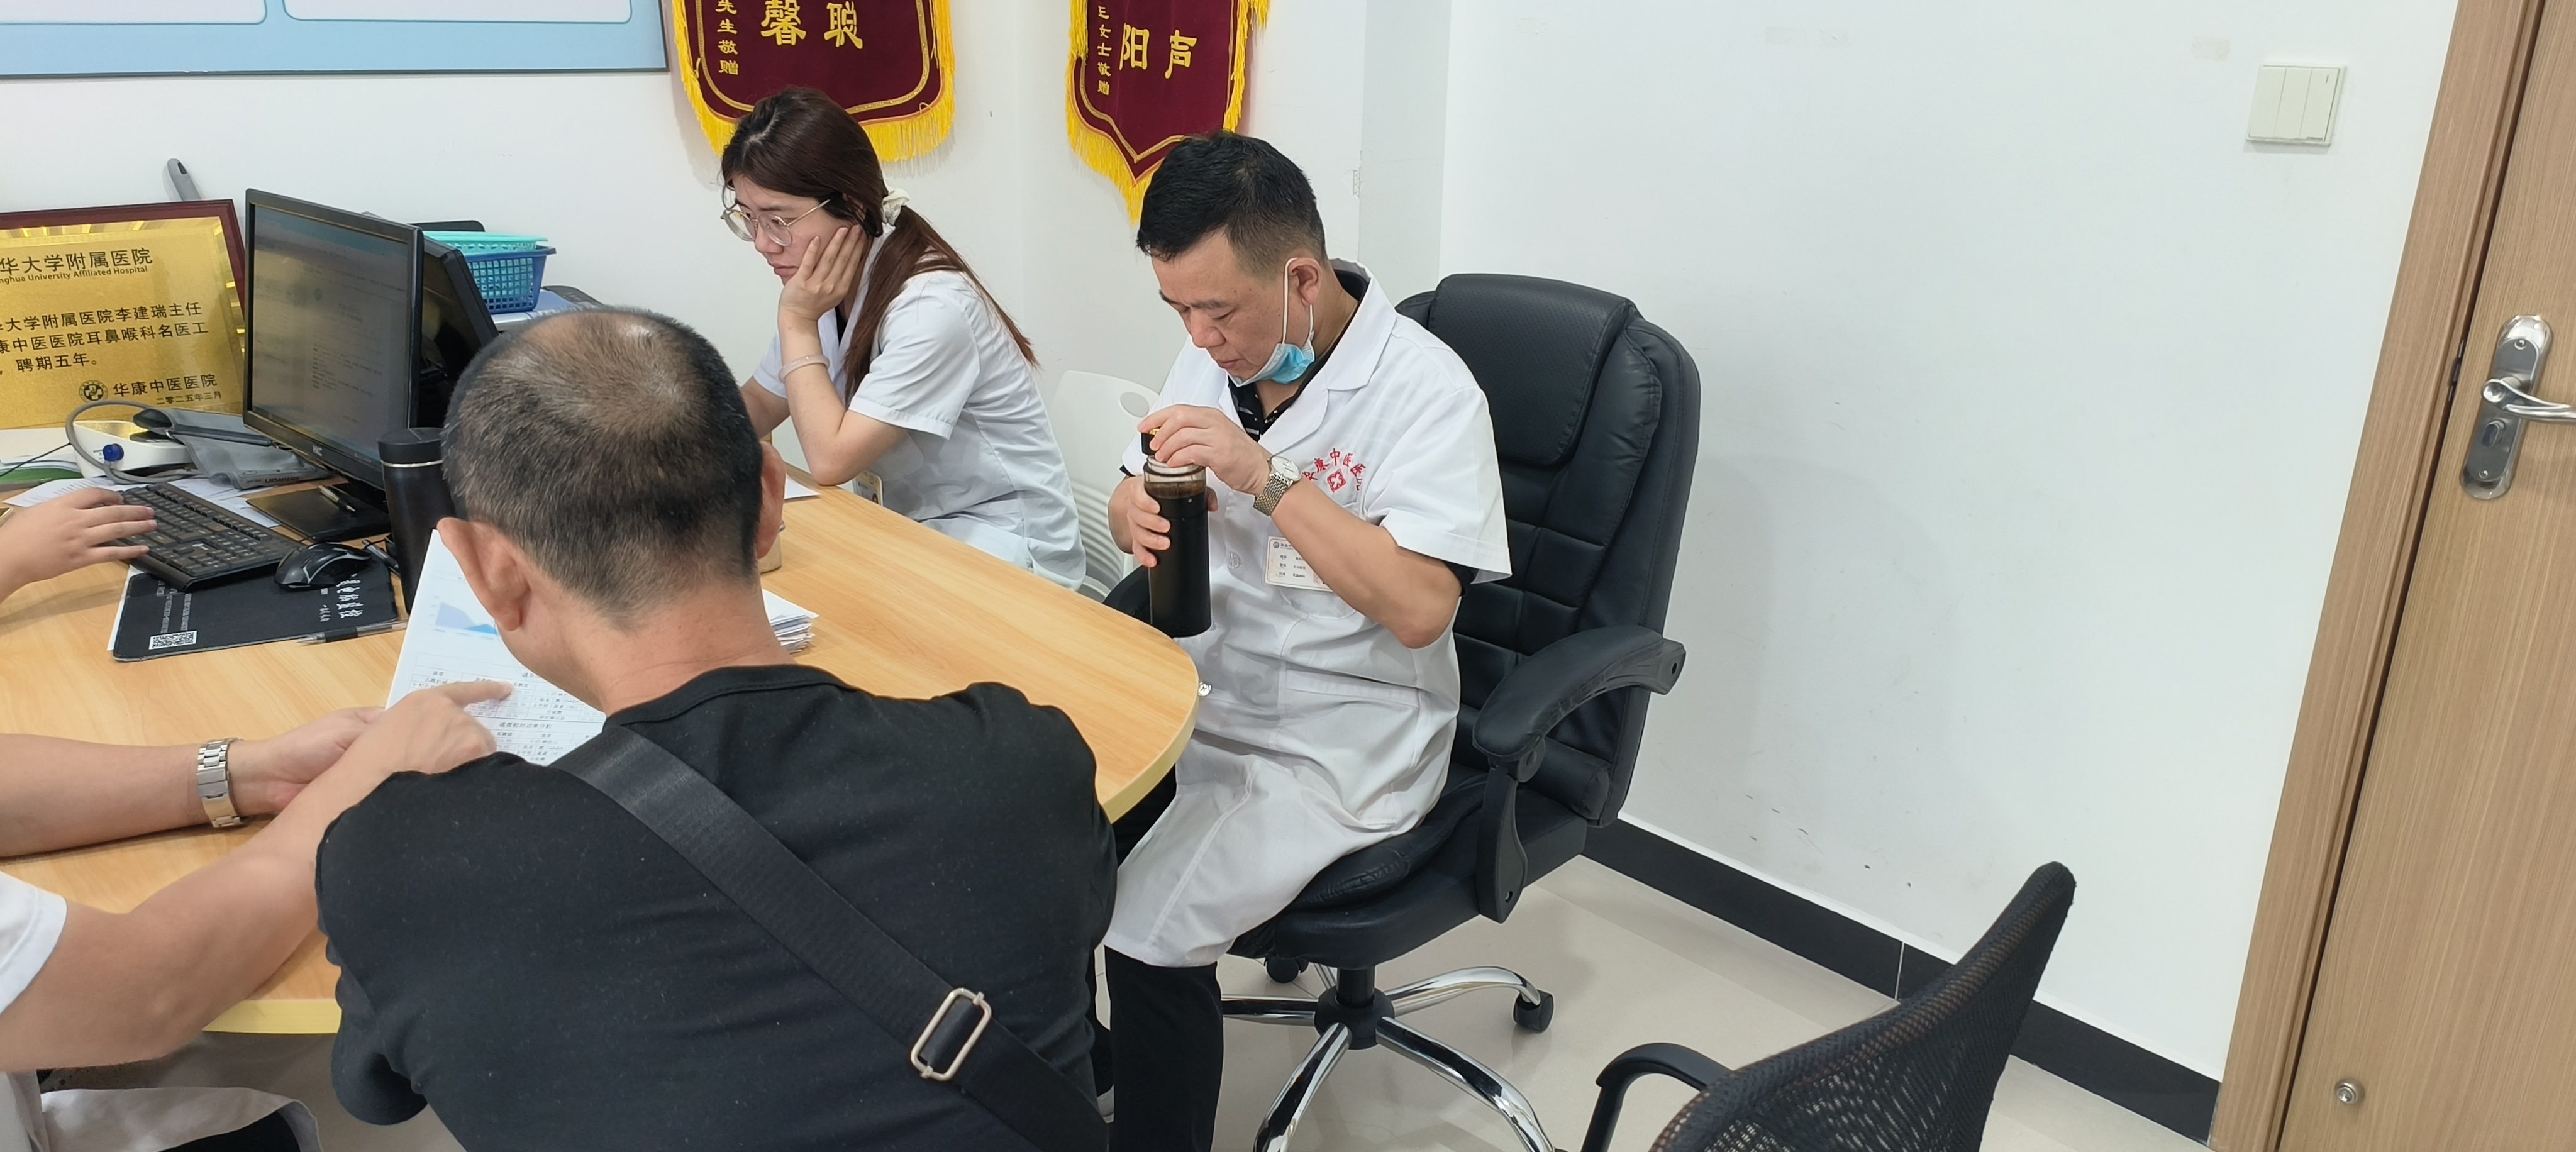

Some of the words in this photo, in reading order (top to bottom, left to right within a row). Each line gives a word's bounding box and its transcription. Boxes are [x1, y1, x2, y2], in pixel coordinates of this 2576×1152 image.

[715, 0, 738, 75] 先生敬赠
[761, 0, 806, 46] 馨
[1119, 23, 1150, 70] 阳
[1165, 30, 1197, 79] 声
[28, 270, 71, 282] University
[73, 266, 112, 278] Affiliated
[113, 265, 148, 275] Hospital
[0, 302, 203, 333] 大学附属医院李建瑞主任
[113, 374, 218, 399] 华康中医医院
[156, 391, 222, 406] 二零二五年三月
